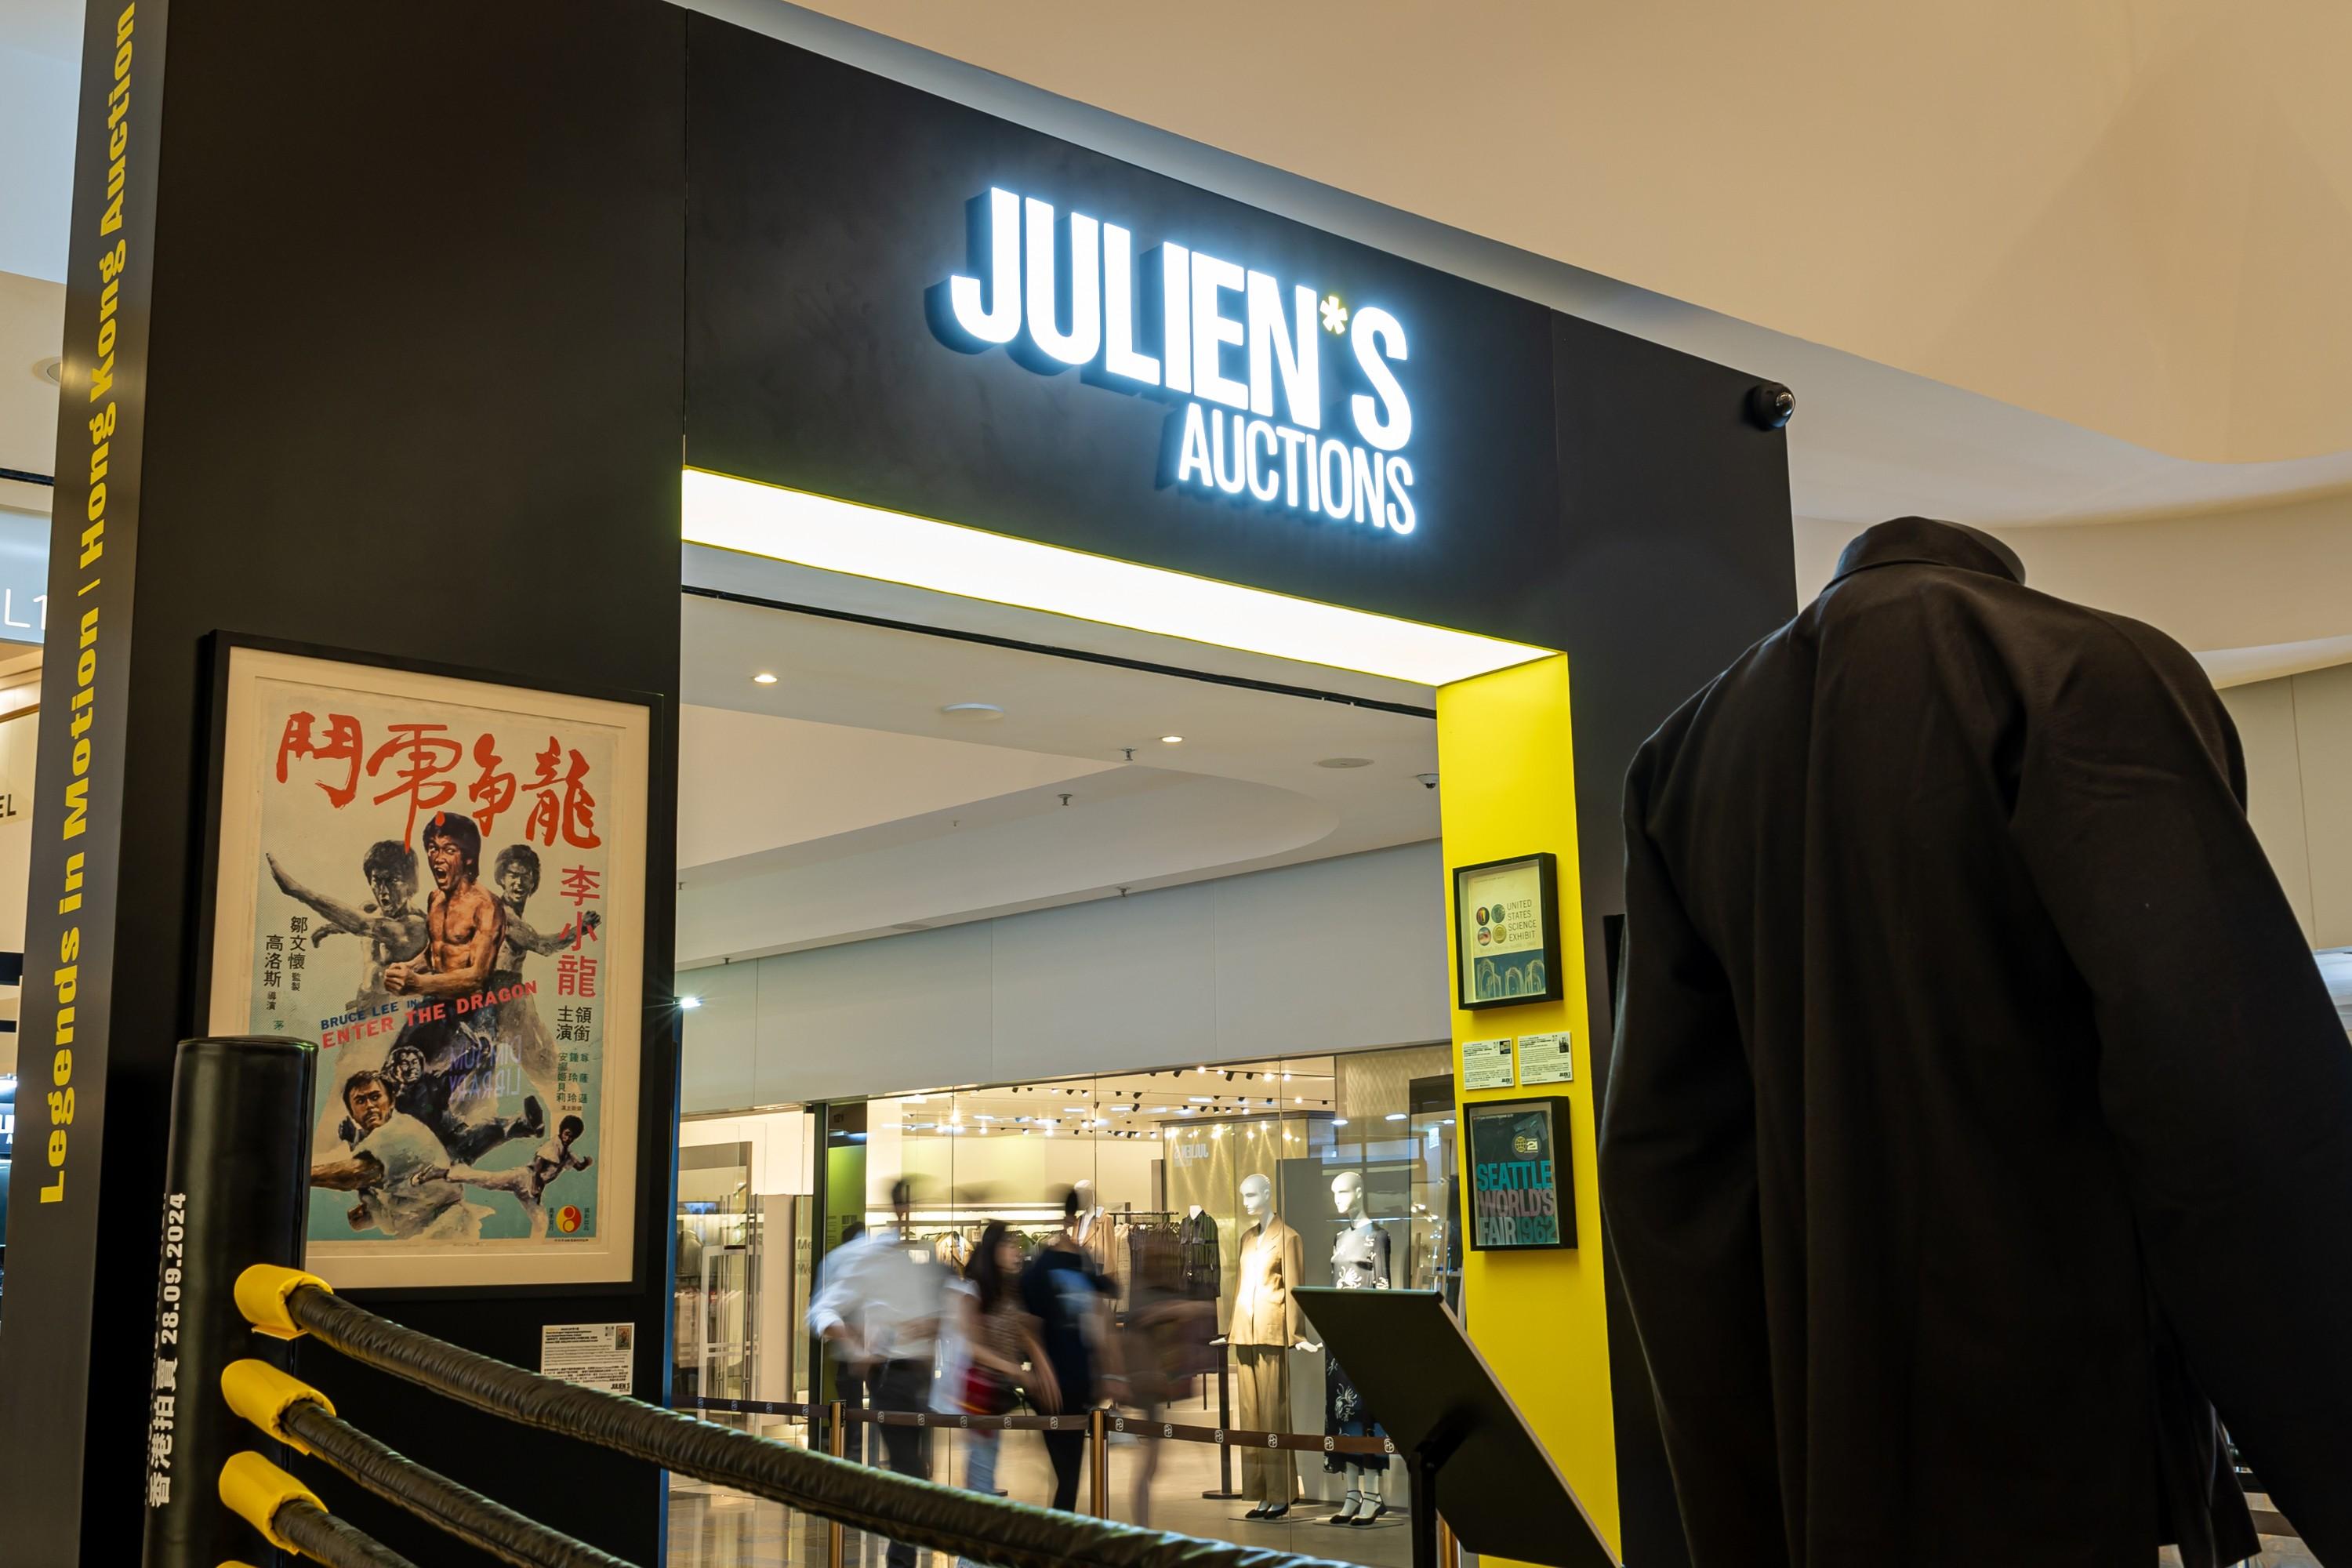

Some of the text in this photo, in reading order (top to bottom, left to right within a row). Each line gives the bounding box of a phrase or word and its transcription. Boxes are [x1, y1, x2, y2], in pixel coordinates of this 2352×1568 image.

[100, 2, 135, 237] Auction
[90, 238, 127, 403] Kong
[79, 401, 117, 569] Hong
[1179, 402, 1416, 535] AUCTIONS
[64, 607, 100, 840] Motion
[59, 851, 85, 914] in
[1507, 899, 1532, 910] UNITED
[1507, 910, 1531, 920] STATES
[557, 865, 602, 1000] 李小龍
[1508, 920, 1537, 931] SCIENCE
[1509, 931, 1535, 942] EXHIBIT
[263, 934, 284, 988] 高洛斯
[321, 999, 417, 1030] BRUCE LEE IN
[322, 980, 538, 1049] ENTER THE DRAGON
[40, 927, 80, 1204] Legends
[1477, 1160, 1552, 1190] SEATTLE
[1478, 1189, 1554, 1218] WORLD'S
[1480, 1217, 1556, 1245] FAIR 1962
[162, 1193, 186, 1345] 28.09.2024
[149, 1356, 178, 1508] 香港拍賣
